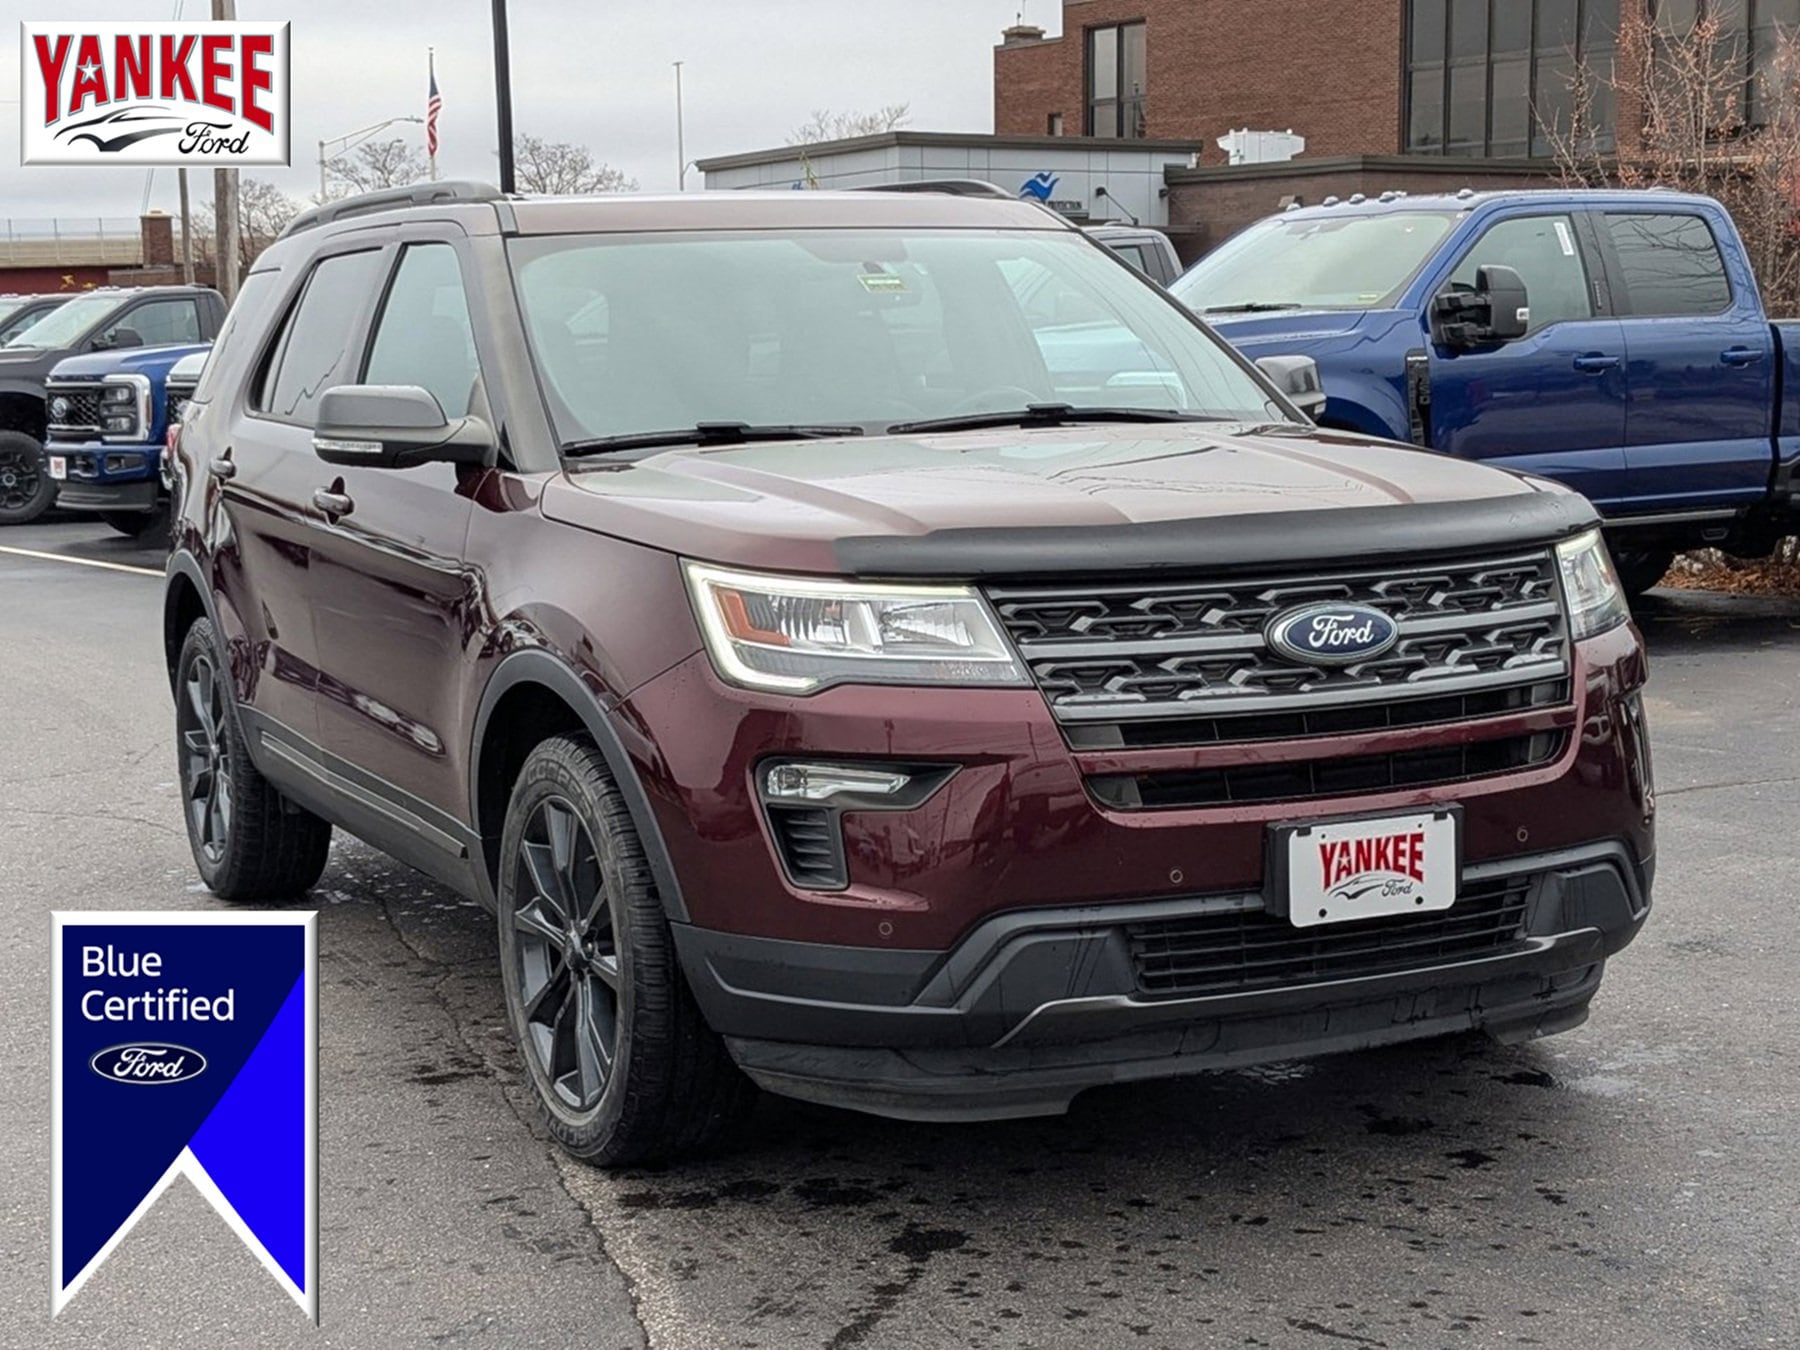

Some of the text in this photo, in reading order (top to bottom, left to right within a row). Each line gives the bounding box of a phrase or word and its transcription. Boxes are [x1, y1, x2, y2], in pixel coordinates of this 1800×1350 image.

[1308, 614, 1374, 647] Ford
[1318, 832, 1425, 891] YANKEE
[1381, 878, 1414, 897] Ford
